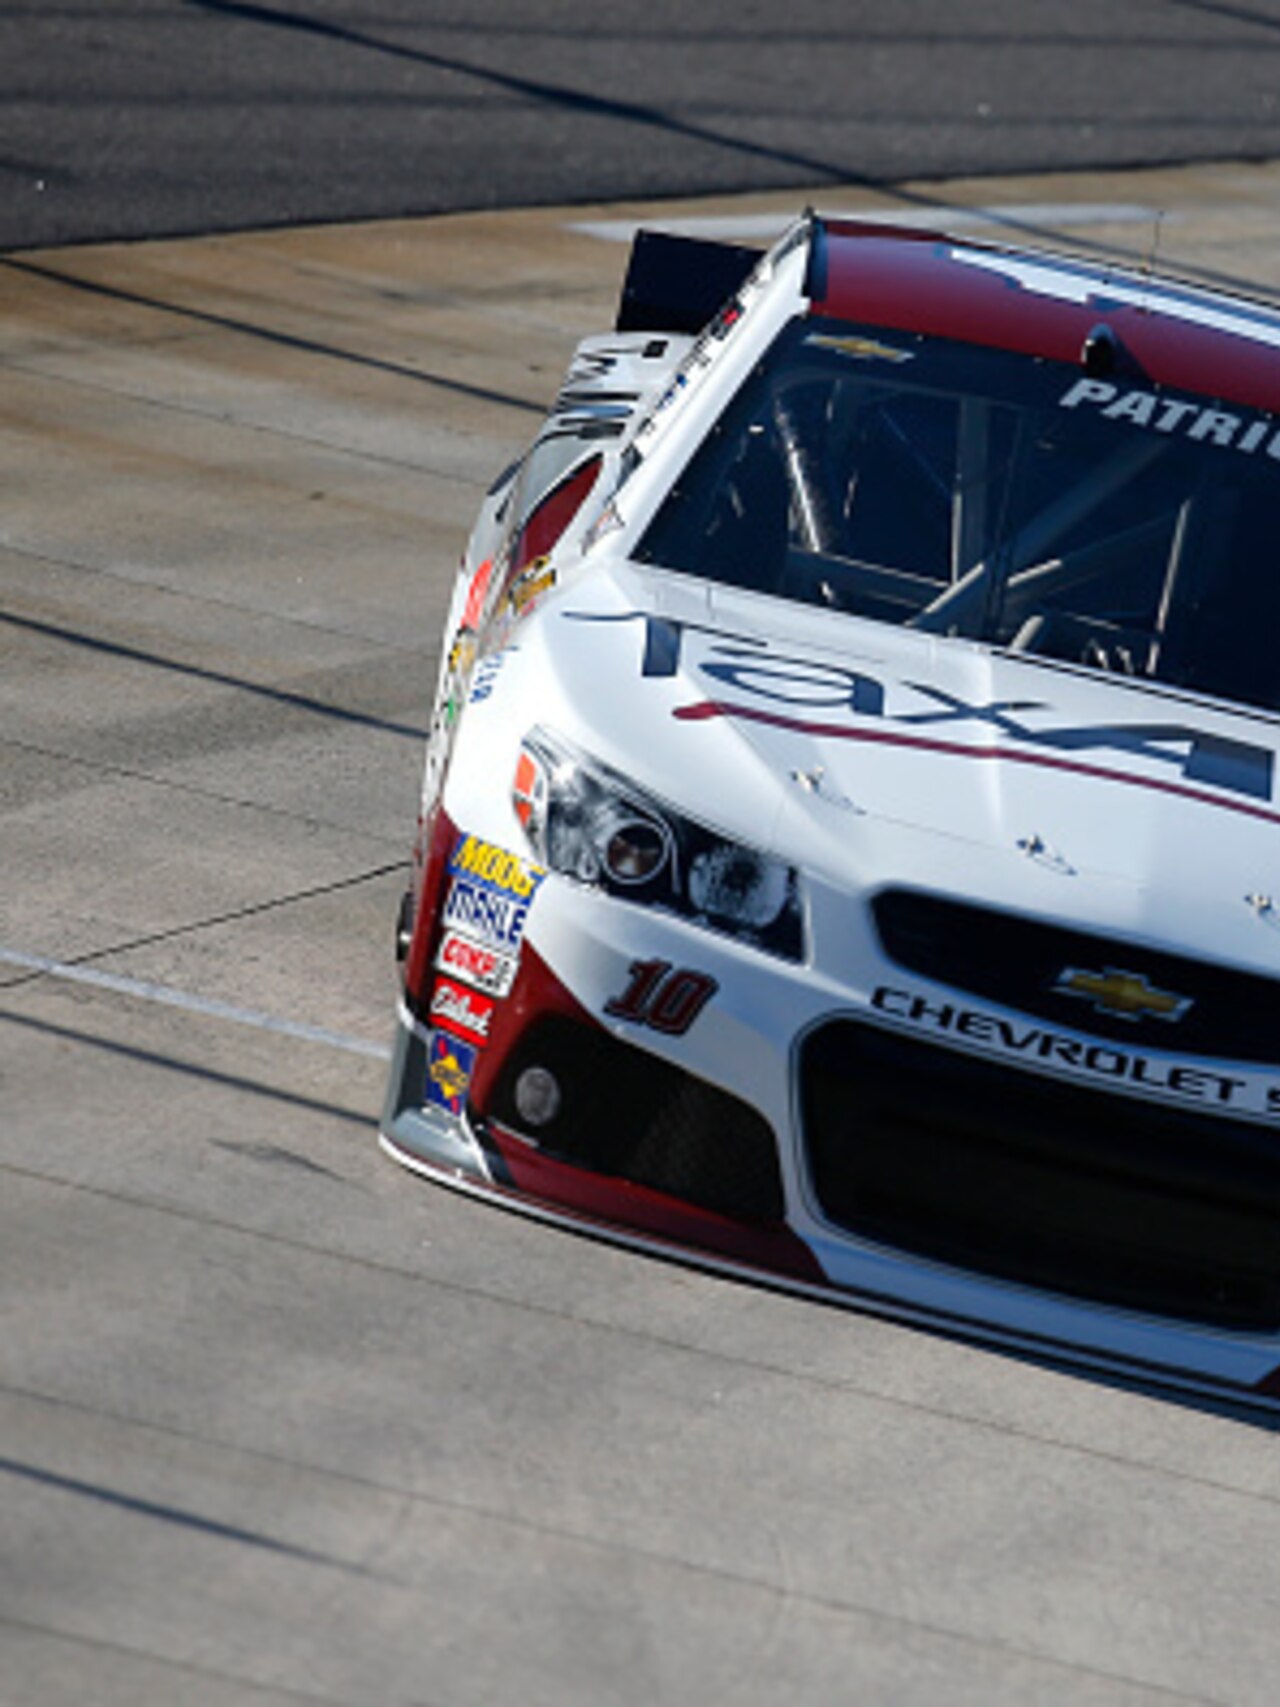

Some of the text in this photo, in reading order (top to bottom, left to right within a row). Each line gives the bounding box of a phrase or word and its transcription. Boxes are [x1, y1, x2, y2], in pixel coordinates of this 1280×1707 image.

[451, 834, 548, 898] MOOG
[602, 957, 721, 1036] 10
[869, 984, 1247, 1103] CHEVROLET
